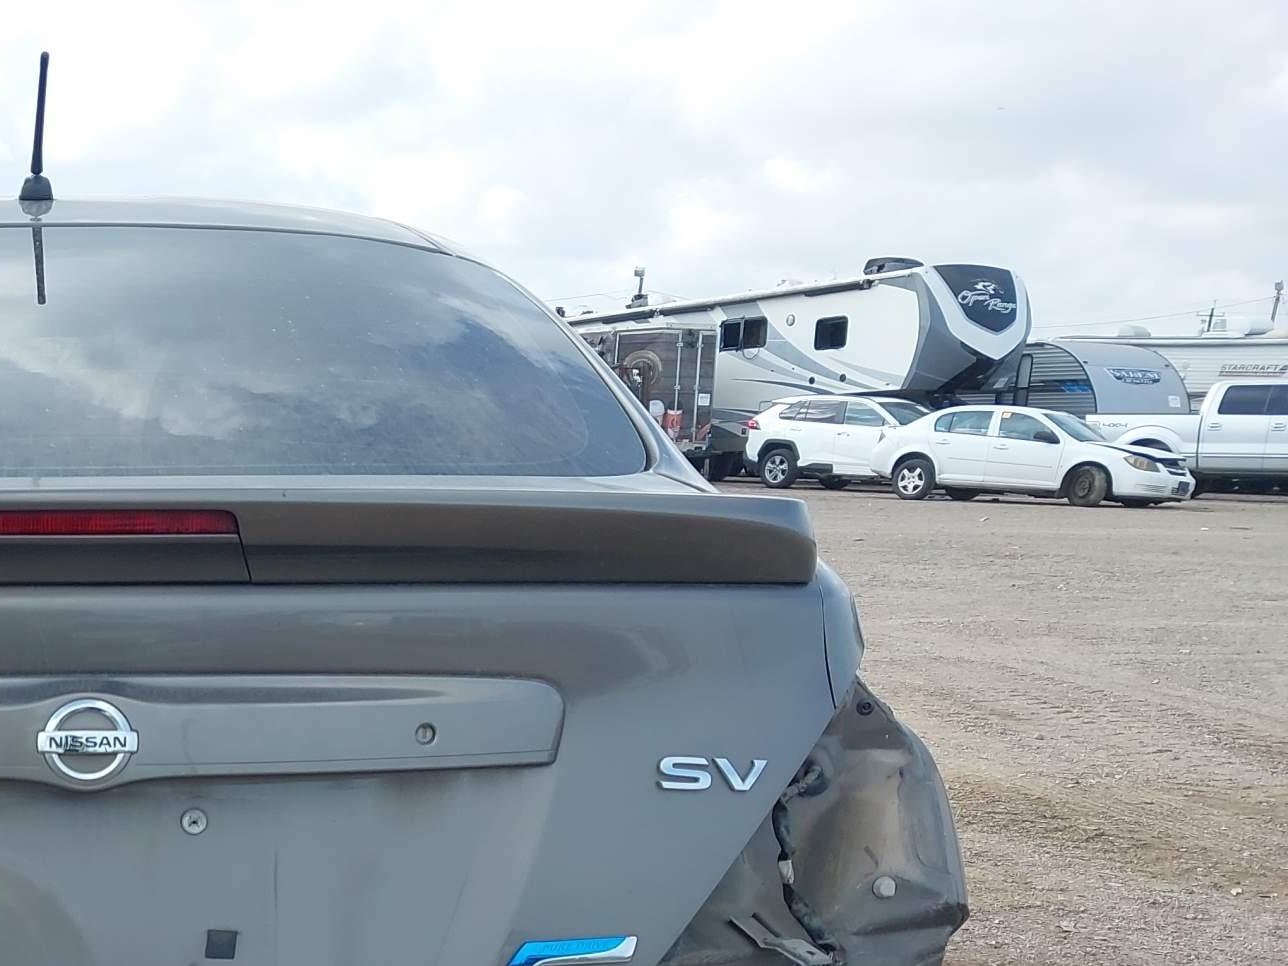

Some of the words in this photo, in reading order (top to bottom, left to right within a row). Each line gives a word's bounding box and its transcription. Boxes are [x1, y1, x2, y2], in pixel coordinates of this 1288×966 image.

[958, 290, 990, 306] Open
[48, 735, 127, 749] NISSAN
[656, 755, 768, 792] SV
